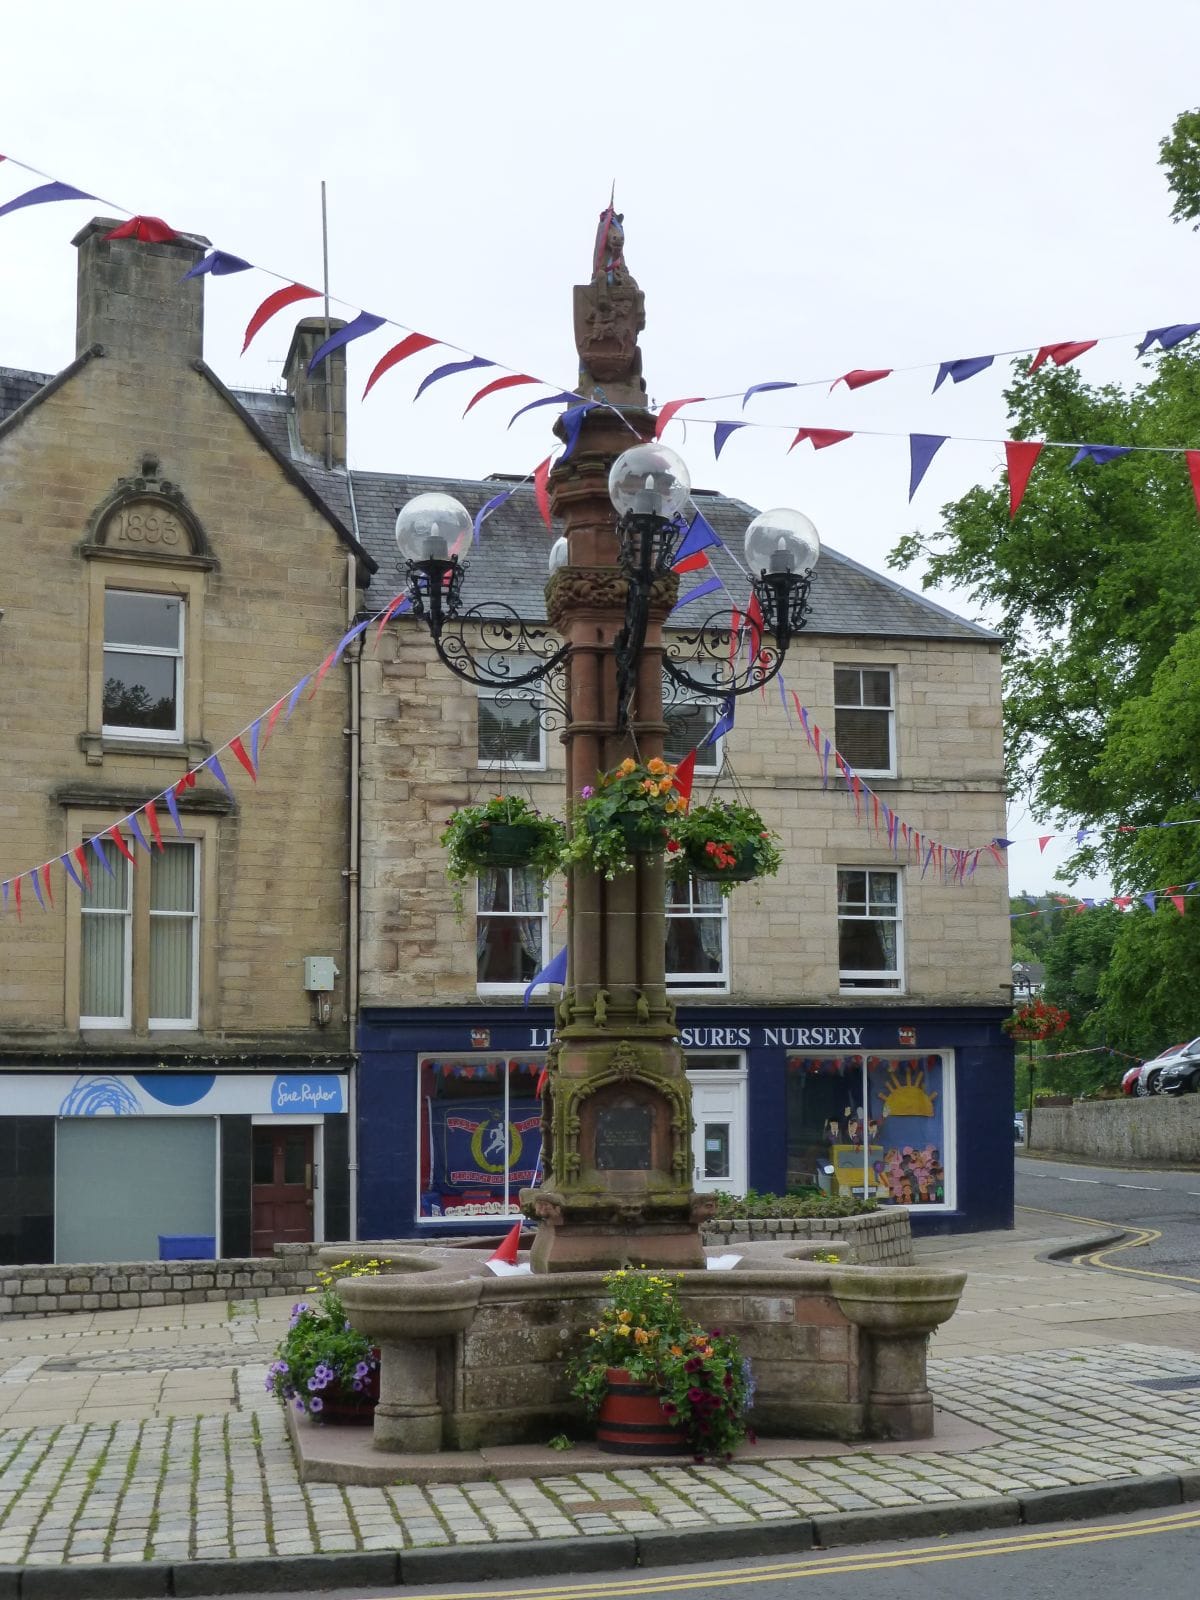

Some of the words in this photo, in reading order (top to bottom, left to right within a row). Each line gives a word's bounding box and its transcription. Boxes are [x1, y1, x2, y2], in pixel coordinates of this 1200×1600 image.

[119, 510, 180, 546] 1893
[672, 1028, 751, 1046] SURES
[763, 1027, 864, 1046] NURSERY
[277, 1082, 301, 1107] Sue
[302, 1083, 336, 1109] Ryder
